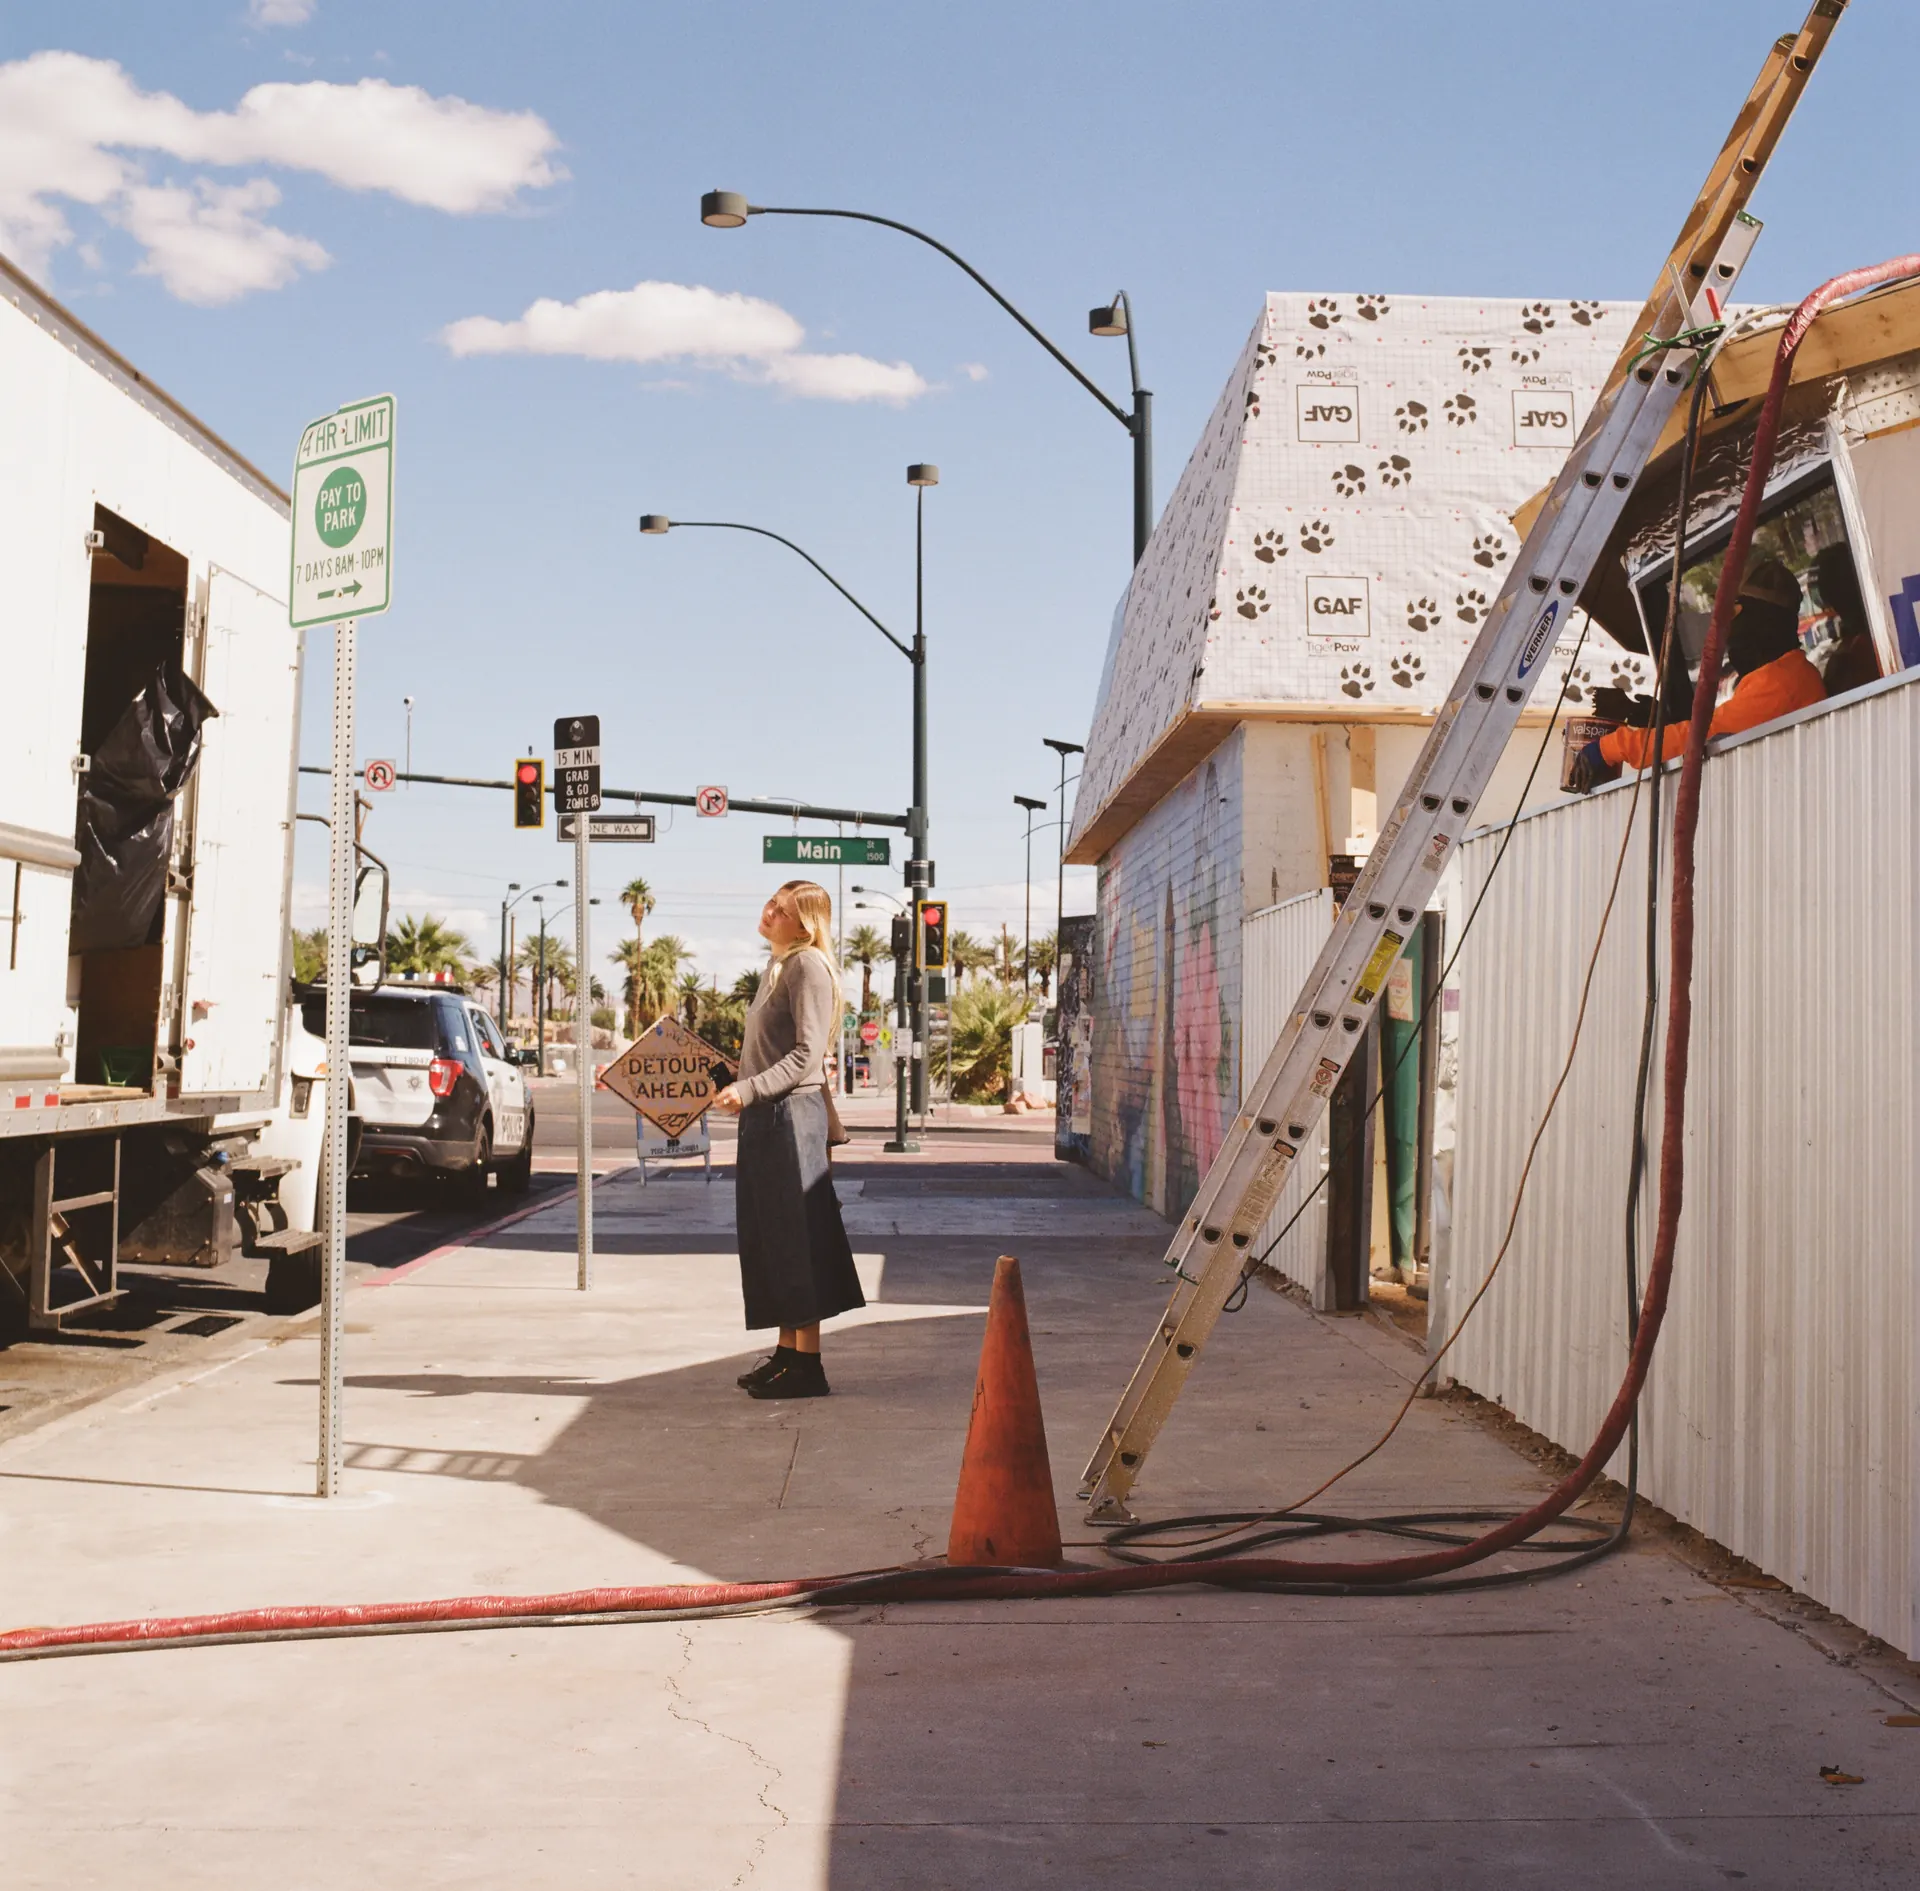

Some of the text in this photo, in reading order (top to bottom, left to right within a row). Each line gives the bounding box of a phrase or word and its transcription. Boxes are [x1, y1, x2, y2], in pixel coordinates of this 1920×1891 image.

[1304, 405, 1352, 423] GAF
[1520, 410, 1567, 428] GAF
[303, 408, 387, 457] 4 HR LIMIT
[320, 482, 361, 510] PAY TO
[324, 506, 356, 532] PARK
[296, 565, 302, 584] 7
[305, 558, 332, 582] DAYS
[1313, 596, 1363, 615] GAF
[1524, 614, 1552, 664] WERNER
[557, 749, 597, 765] 15 MIN.
[565, 769, 589, 782] GRAB
[566, 783, 589, 796] & GO
[566, 797, 589, 810] ZONE
[614, 824, 640, 834] WAY
[766, 839, 875, 859] S Main St
[628, 1057, 711, 1075] DETOUR
[636, 1082, 708, 1099] AHEAD
